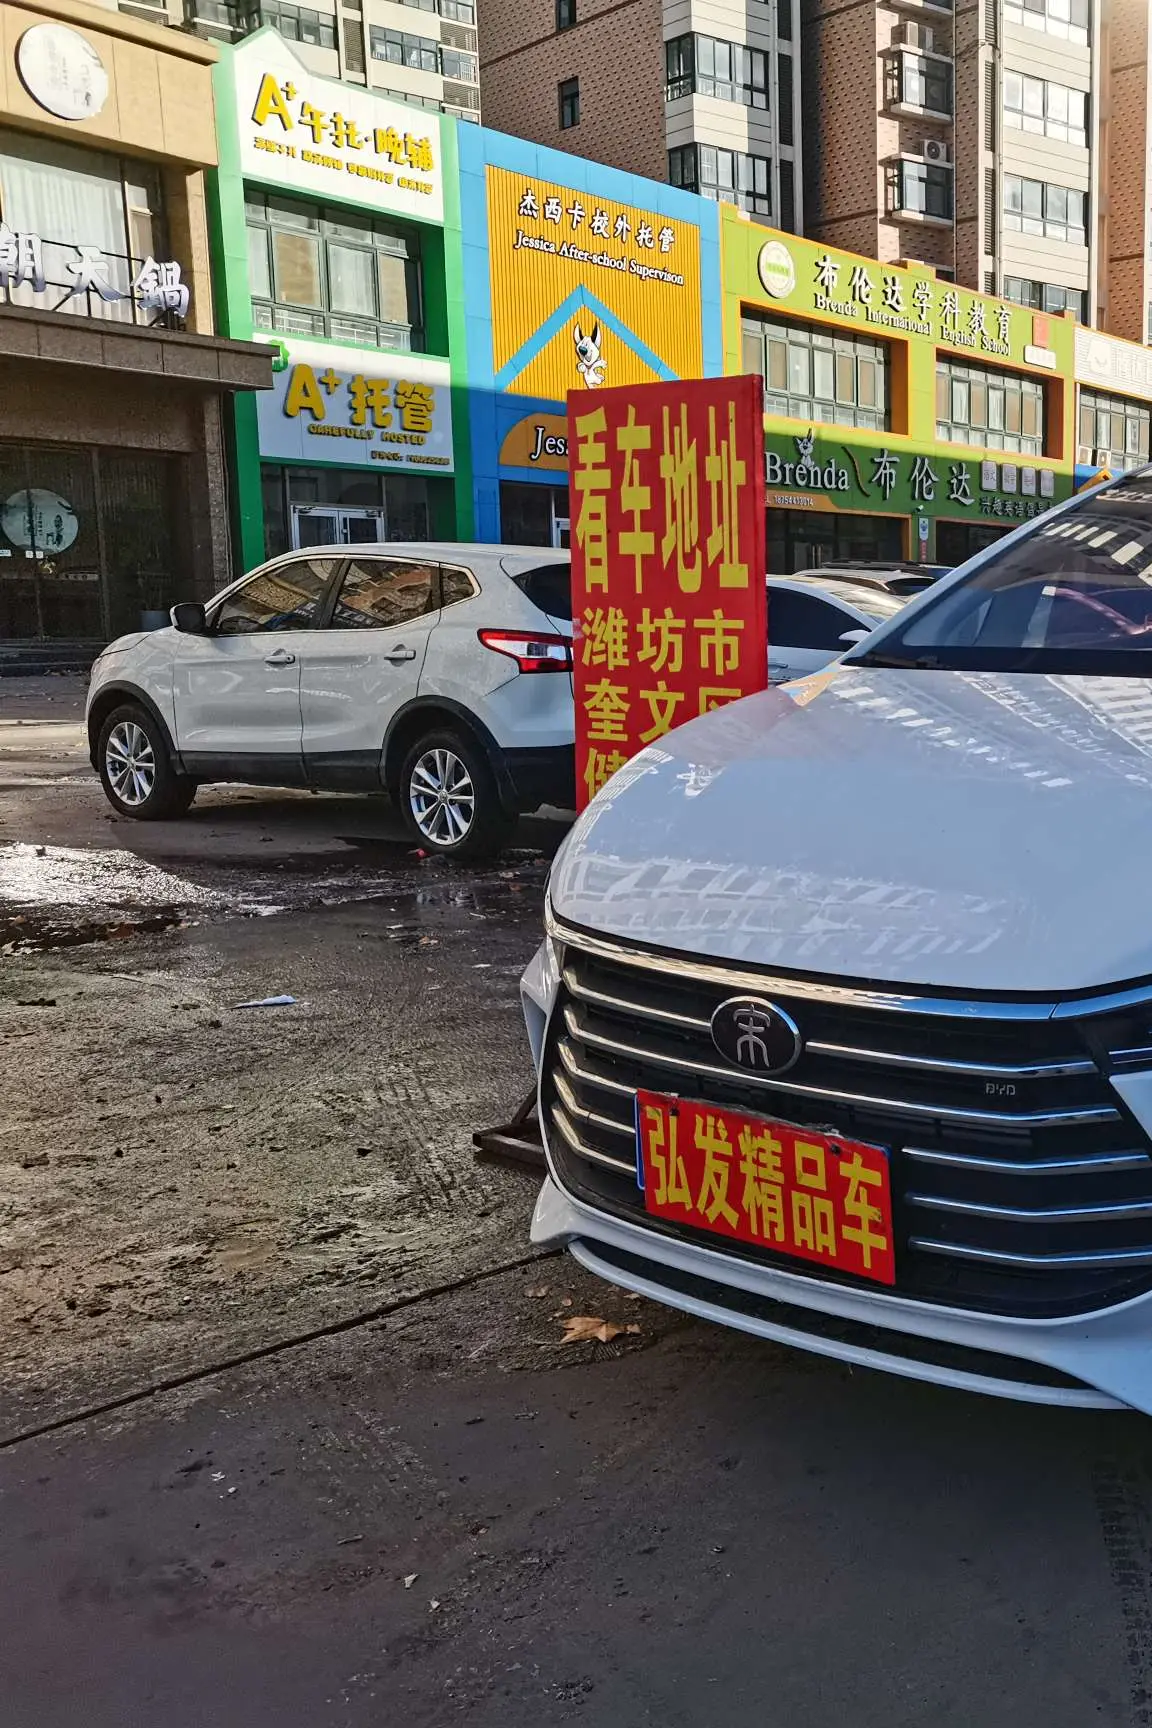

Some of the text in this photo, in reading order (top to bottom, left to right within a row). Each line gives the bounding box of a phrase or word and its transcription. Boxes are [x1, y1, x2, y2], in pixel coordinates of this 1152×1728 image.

[514, 230, 556, 254] Jessica
[559, 241, 627, 272] After-school
[518, 188, 675, 253] 杰西卡校外托管
[814, 255, 1012, 344] 布伦达学科教育
[814, 293, 1010, 356] Brenda International English School
[530, 425, 569, 460] Jes
[765, 450, 850, 491] Brenda
[575, 401, 749, 594] 看车地址
[872, 448, 975, 506] 布伦达
[581, 607, 744, 676] 潍坊市
[986, 1082, 1016, 1096] BYD
[646, 1106, 888, 1269] 弘发精品车
